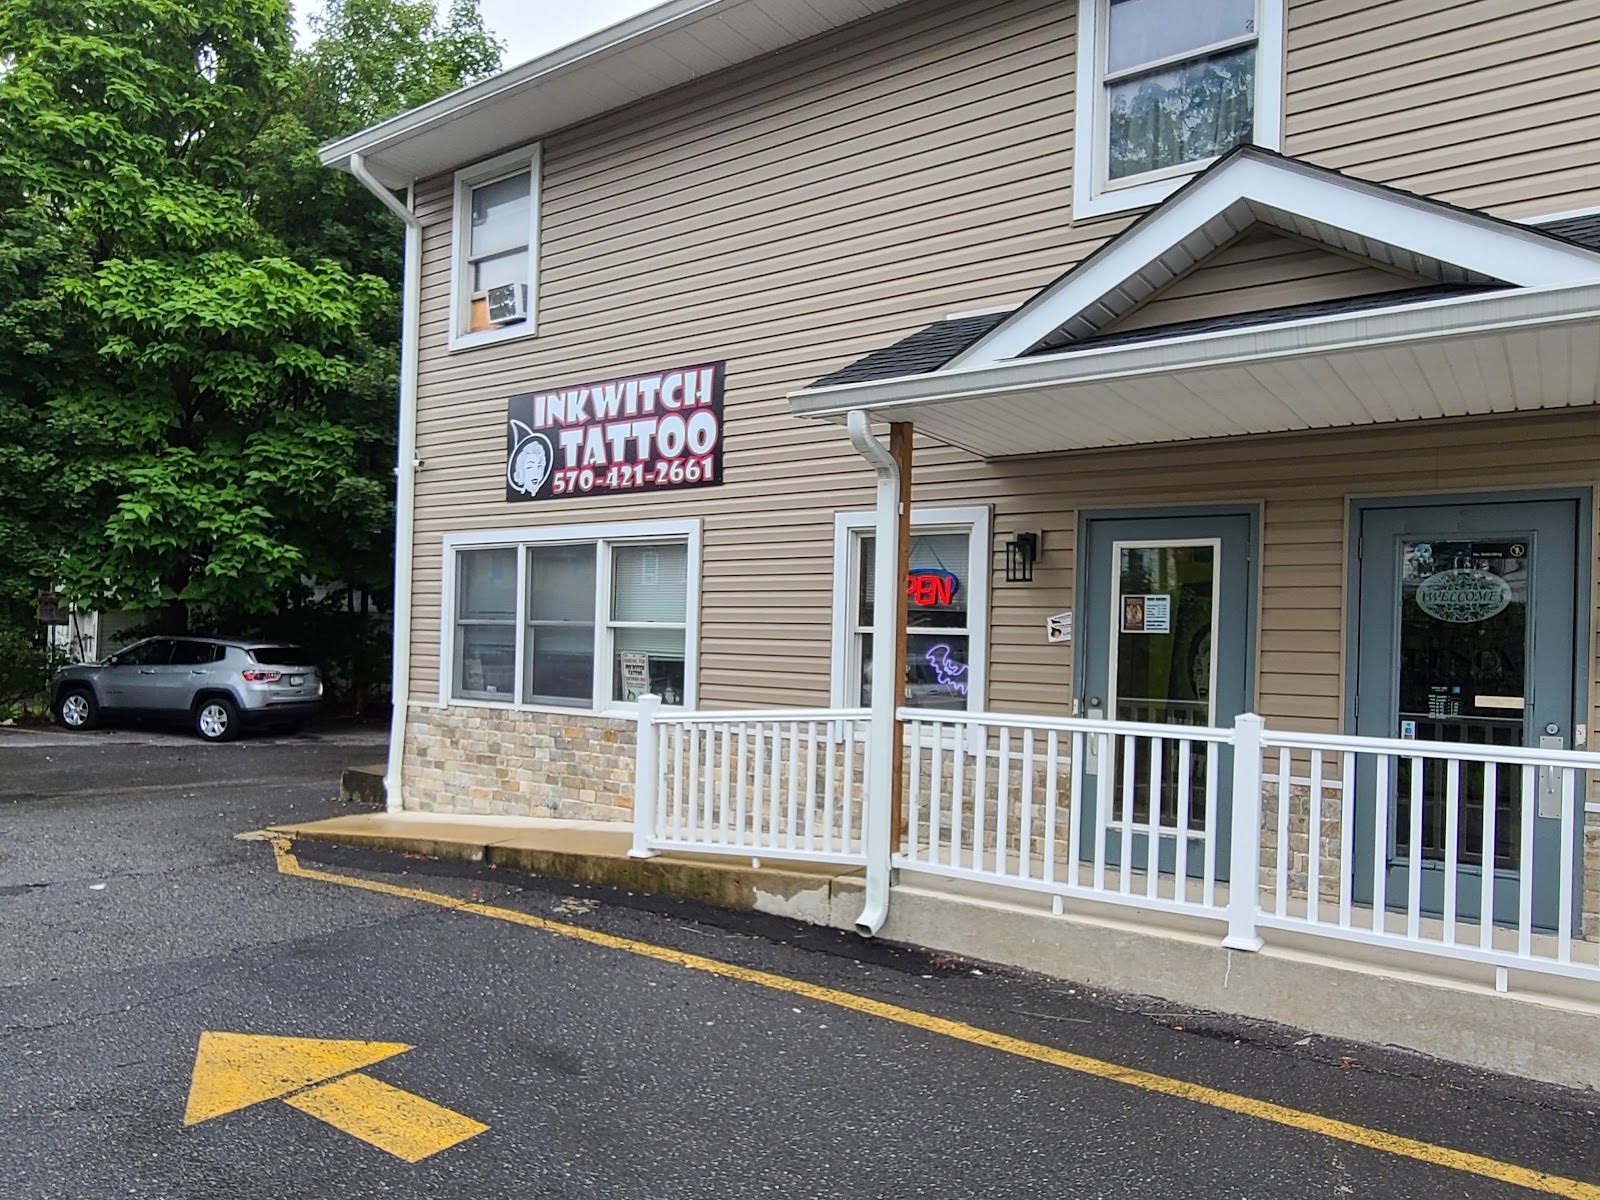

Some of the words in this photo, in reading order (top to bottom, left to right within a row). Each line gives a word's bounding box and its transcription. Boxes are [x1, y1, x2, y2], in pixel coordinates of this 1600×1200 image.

[534, 367, 715, 429] INKWITCH
[558, 409, 718, 467] TATTOO
[552, 454, 714, 495] 570-421-2661
[906, 575, 953, 605] PEN
[1427, 591, 1497, 602] WELCOME
